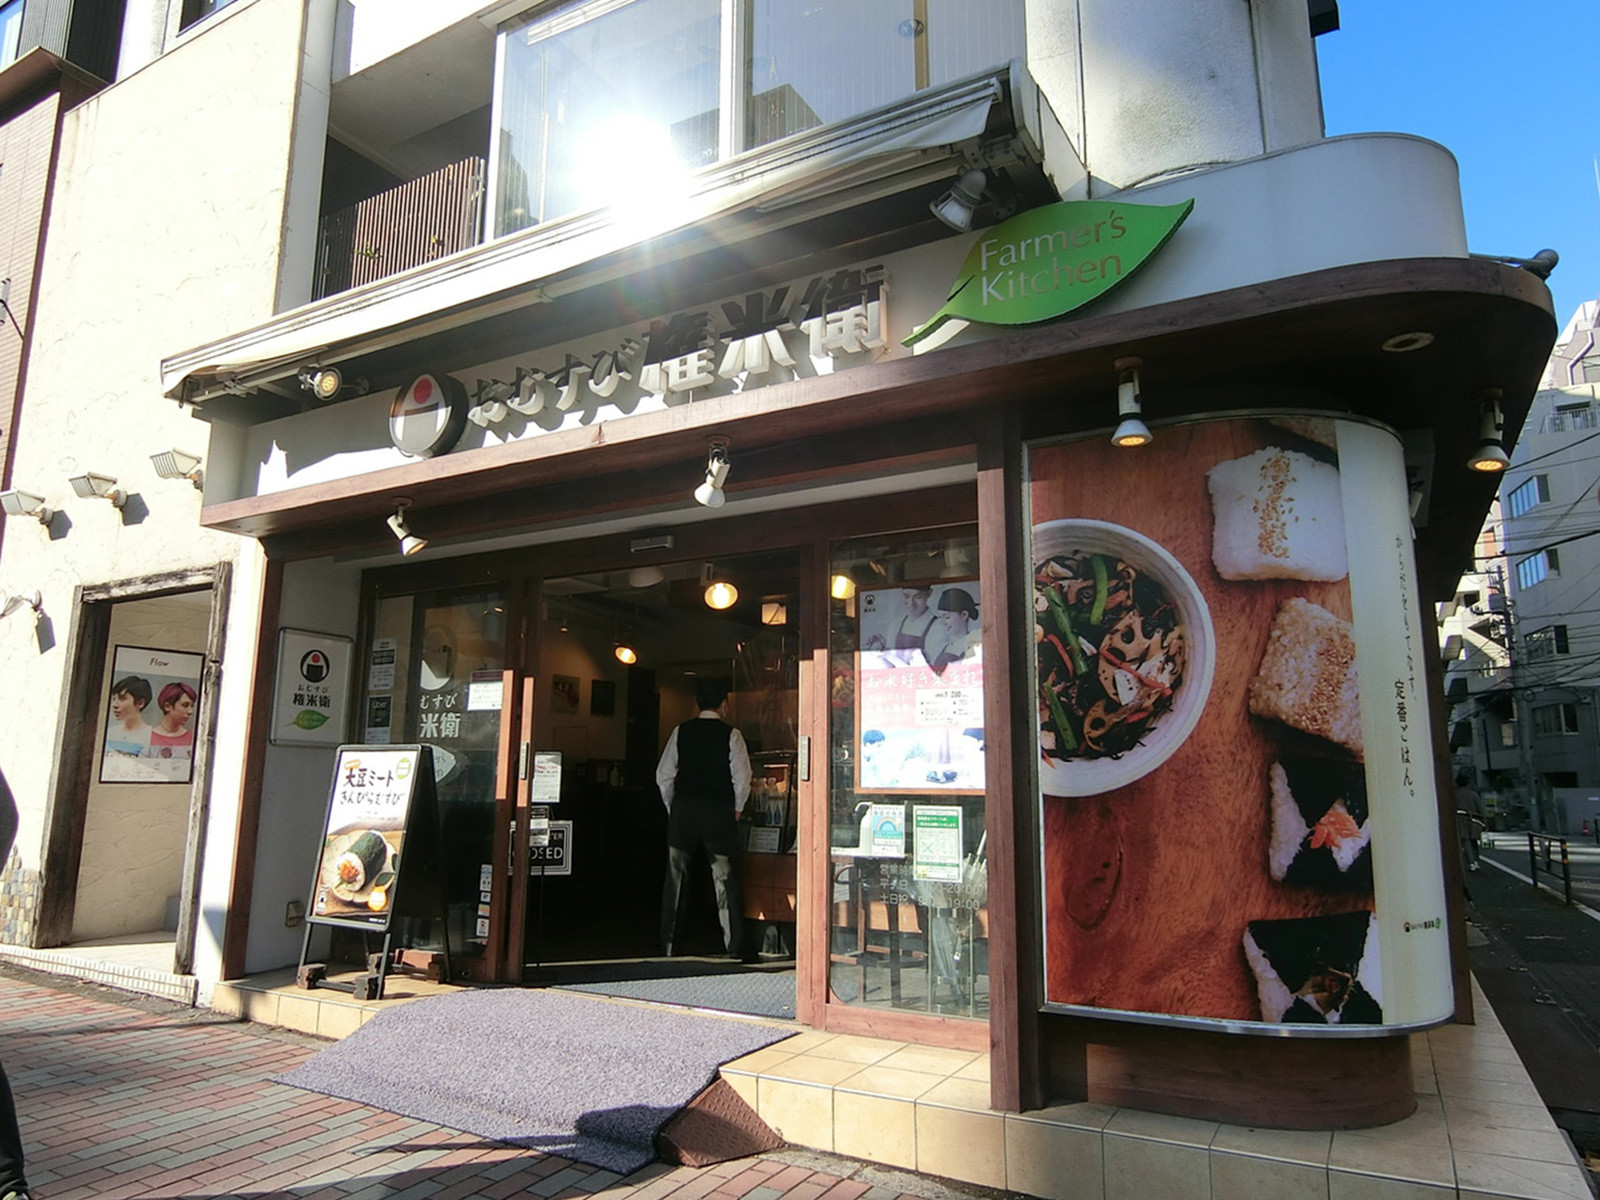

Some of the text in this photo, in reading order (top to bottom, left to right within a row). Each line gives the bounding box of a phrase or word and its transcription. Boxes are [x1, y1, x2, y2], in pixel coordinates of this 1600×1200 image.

[980, 209, 1127, 272] Farmer's
[981, 254, 1122, 307] Kitchen
[297, 684, 330, 694] おむすび
[419, 712, 462, 738] 米衛
[1394, 678, 1414, 797] 定番ごはん。
[343, 767, 394, 788] 大豆ミート
